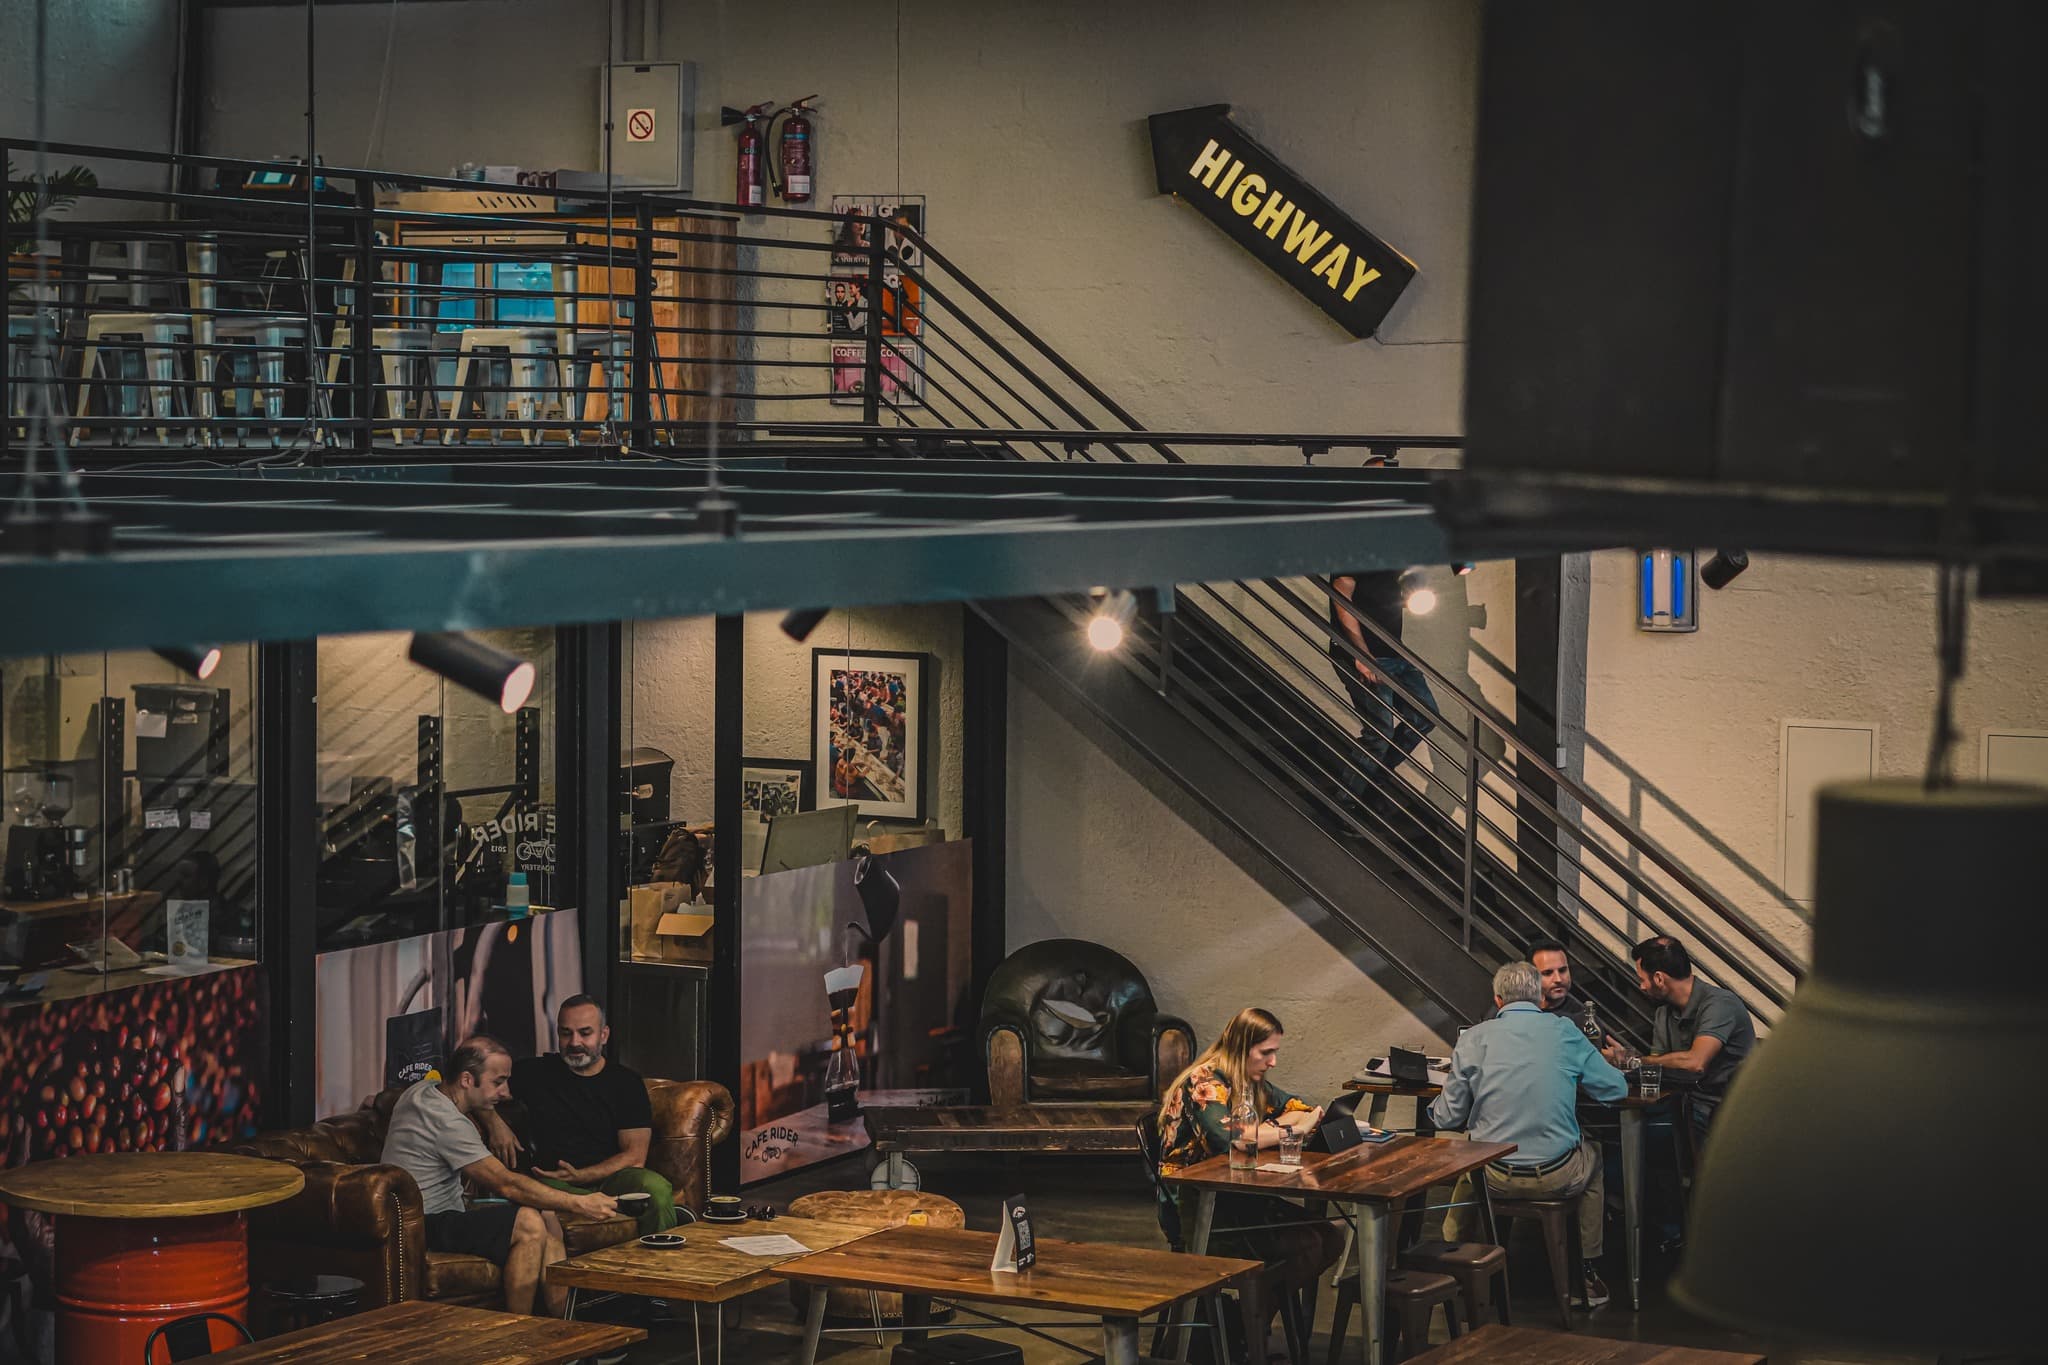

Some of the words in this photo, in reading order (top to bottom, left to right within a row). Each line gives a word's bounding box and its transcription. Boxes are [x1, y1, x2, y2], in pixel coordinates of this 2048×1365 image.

[1188, 138, 1382, 302] HIGHWAY
[398, 1064, 414, 1078] CAFE
[745, 1130, 767, 1159] CAFE
[770, 1126, 799, 1147] RIDER
